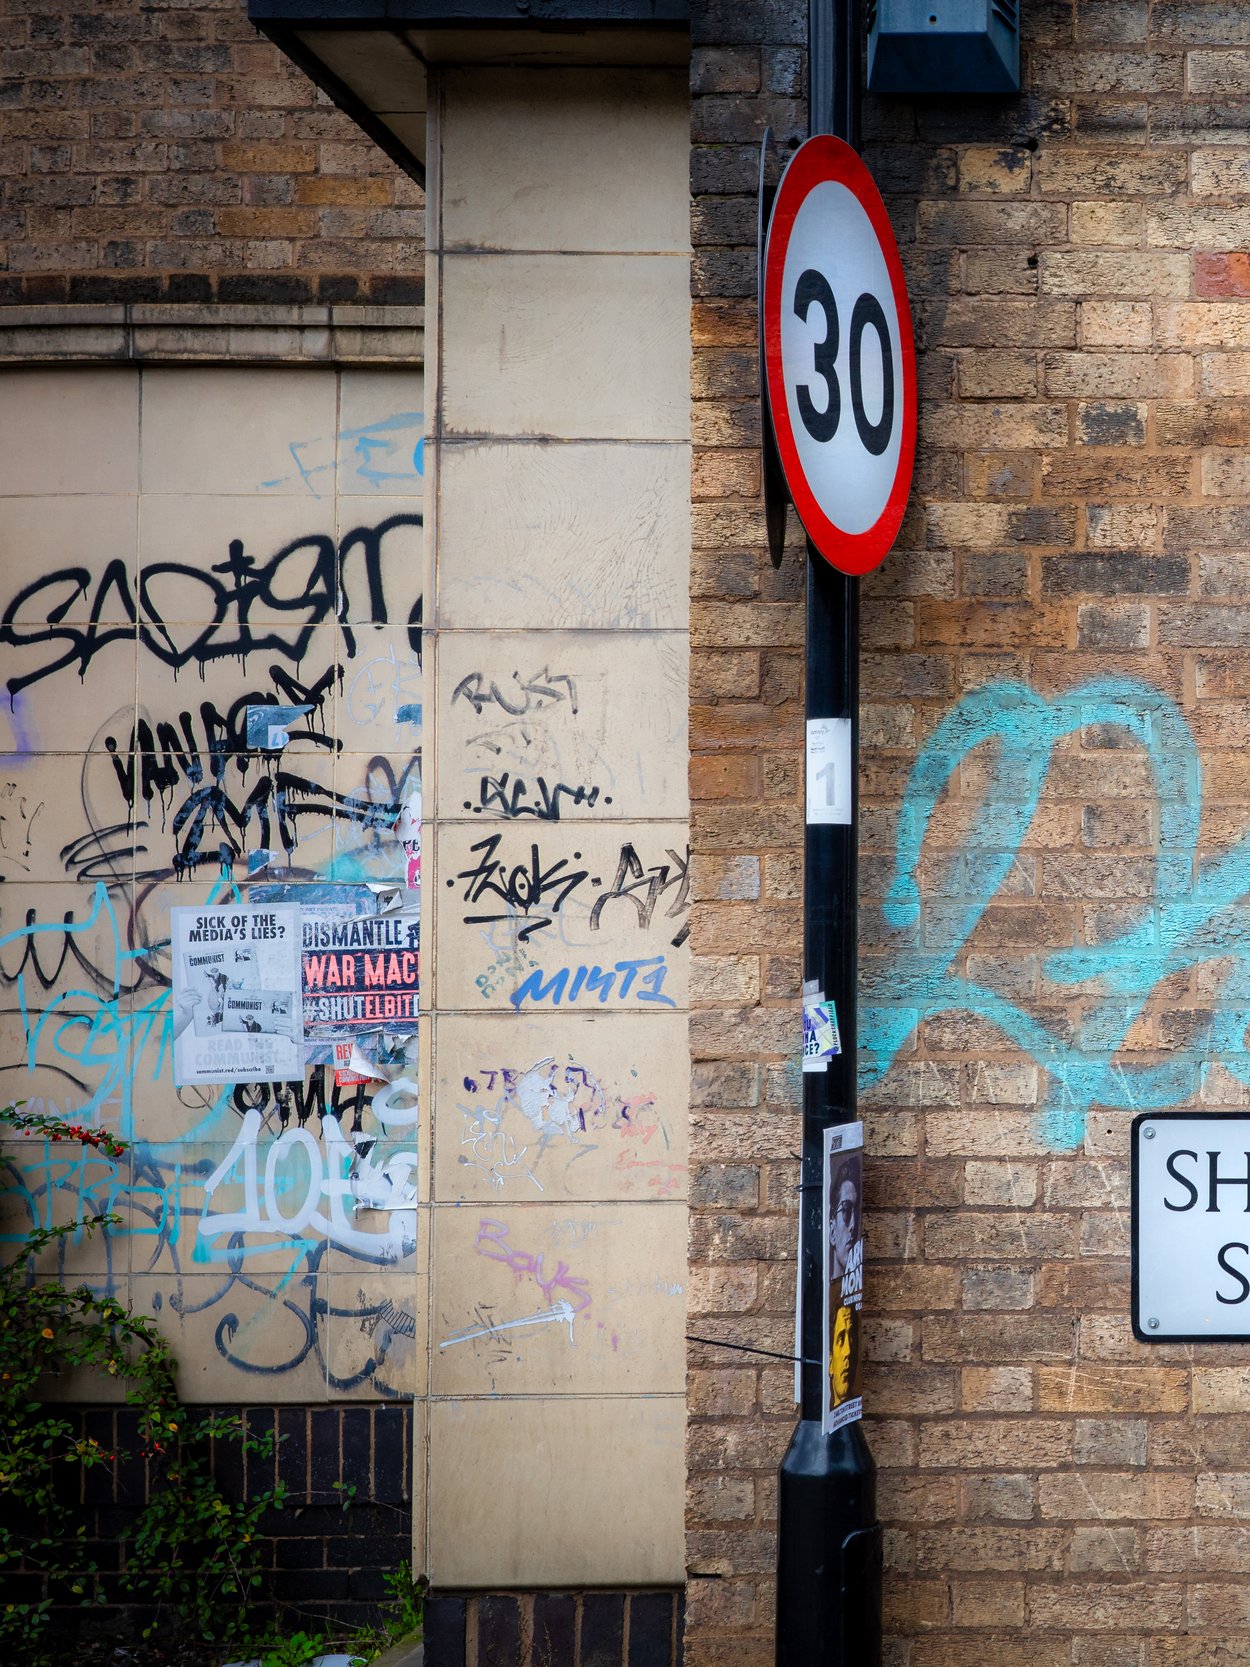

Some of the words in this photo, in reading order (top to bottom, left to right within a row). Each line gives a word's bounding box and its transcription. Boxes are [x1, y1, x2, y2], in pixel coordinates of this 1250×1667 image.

[794, 268, 894, 457] 30
[816, 762, 836, 806] 1
[196, 916, 226, 929] SICK
[231, 915, 248, 928] OF
[252, 914, 276, 927] THE
[189, 928, 246, 942] MEDIA'S
[251, 926, 286, 940] LIES?
[302, 919, 403, 948] DISMANTLE
[189, 953, 225, 967] COMMUNIST
[304, 954, 356, 988] WAR
[364, 952, 420, 987] MAC
[227, 1000, 263, 1011] COMMUNIST
[196, 1066, 262, 1075] communist.red/subscribe
